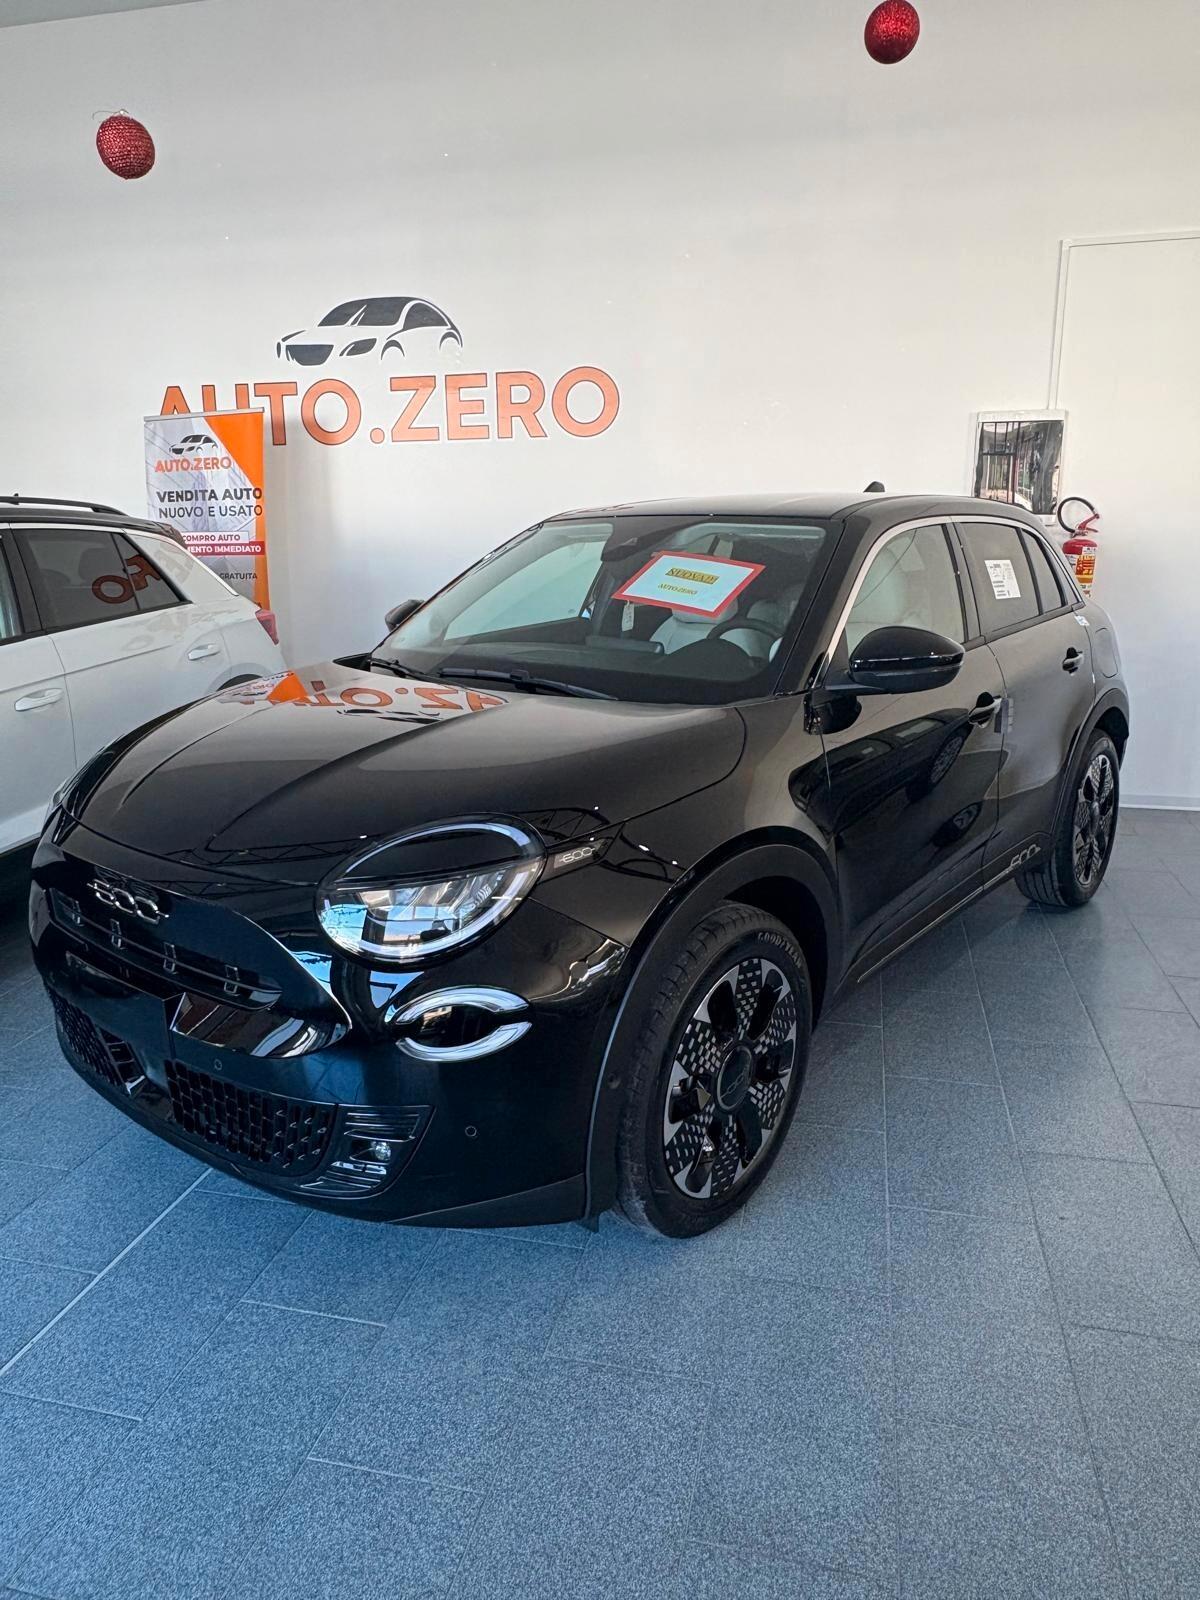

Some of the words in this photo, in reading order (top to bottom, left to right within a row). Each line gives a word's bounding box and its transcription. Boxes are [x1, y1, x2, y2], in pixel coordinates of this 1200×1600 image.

[155, 456, 232, 473] AUTO.ZERO
[157, 489, 218, 503] VENDITA
[222, 487, 262, 501] AUTO
[159, 506, 204, 519] NUOVO
[208, 506, 216, 517] E
[219, 504, 263, 517] USATO
[218, 534, 241, 542] AUTO
[220, 572, 257, 580] GRATUITA
